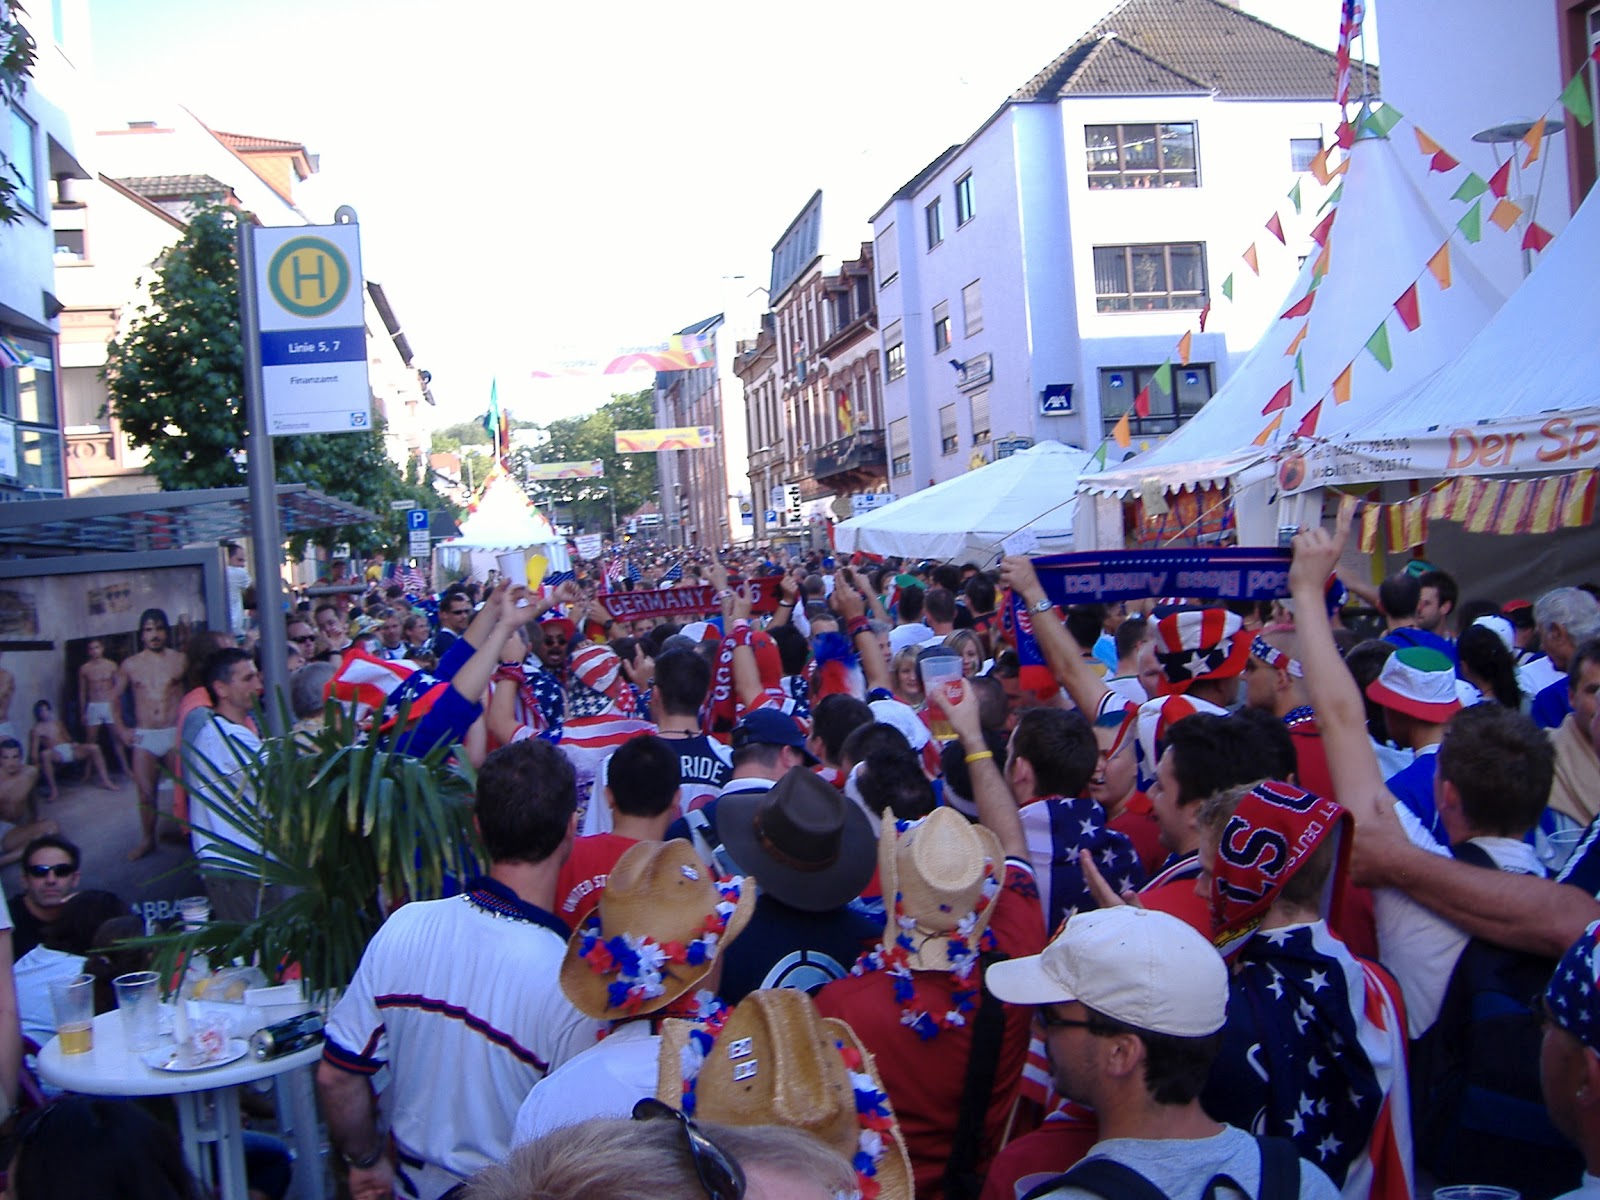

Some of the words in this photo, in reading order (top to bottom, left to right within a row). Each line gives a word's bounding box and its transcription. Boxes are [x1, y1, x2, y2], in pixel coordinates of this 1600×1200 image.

[292, 255, 326, 299] H
[288, 342, 315, 353] Linie
[318, 341, 330, 352] 5,
[333, 341, 341, 351] 7
[290, 376, 339, 385] Finanzamt
[1044, 395, 1069, 408] AXA
[1446, 428, 1526, 469] Der
[413, 512, 425, 527] P
[1064, 571, 1168, 599] America
[1177, 570, 1240, 596] Bless
[1247, 570, 1290, 597] God
[606, 587, 709, 616] GERMANY
